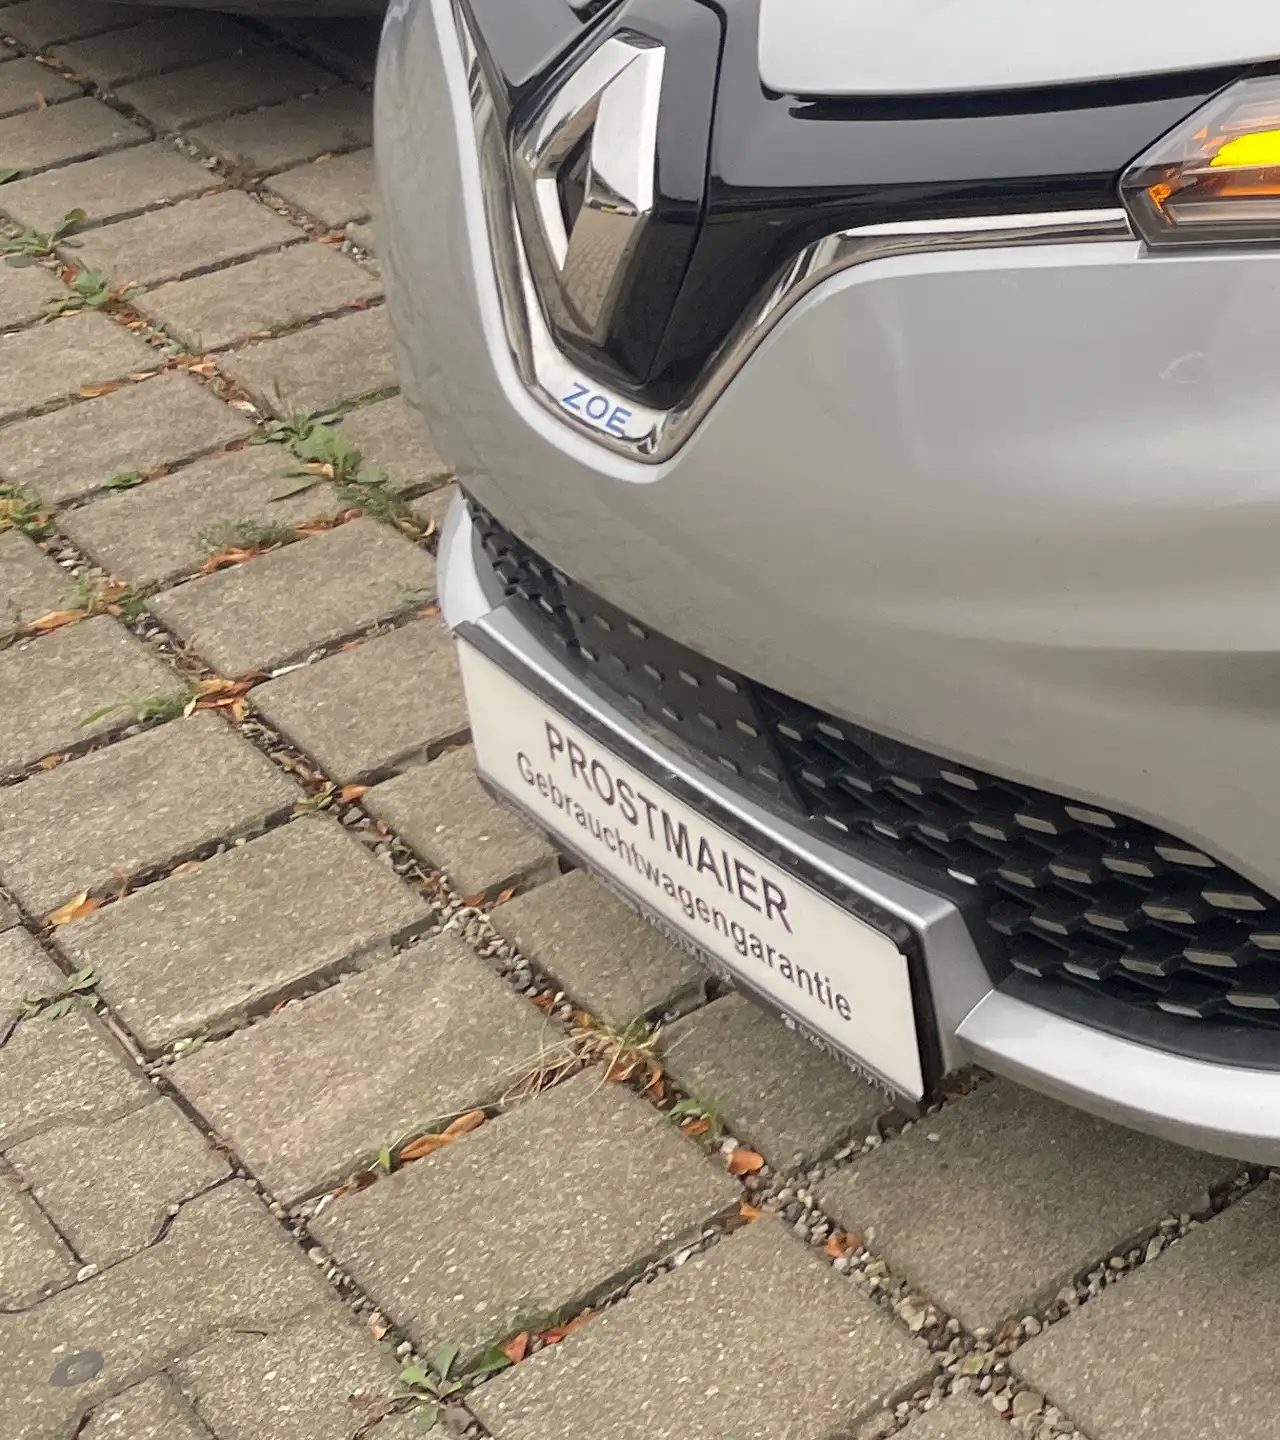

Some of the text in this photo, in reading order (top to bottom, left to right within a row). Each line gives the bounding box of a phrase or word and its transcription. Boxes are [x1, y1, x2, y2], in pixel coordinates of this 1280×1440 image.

[561, 381, 632, 435] ZOE
[517, 751, 853, 1022] Gebrauchtwagengarantie
[545, 719, 794, 934] PROSTMAIER
